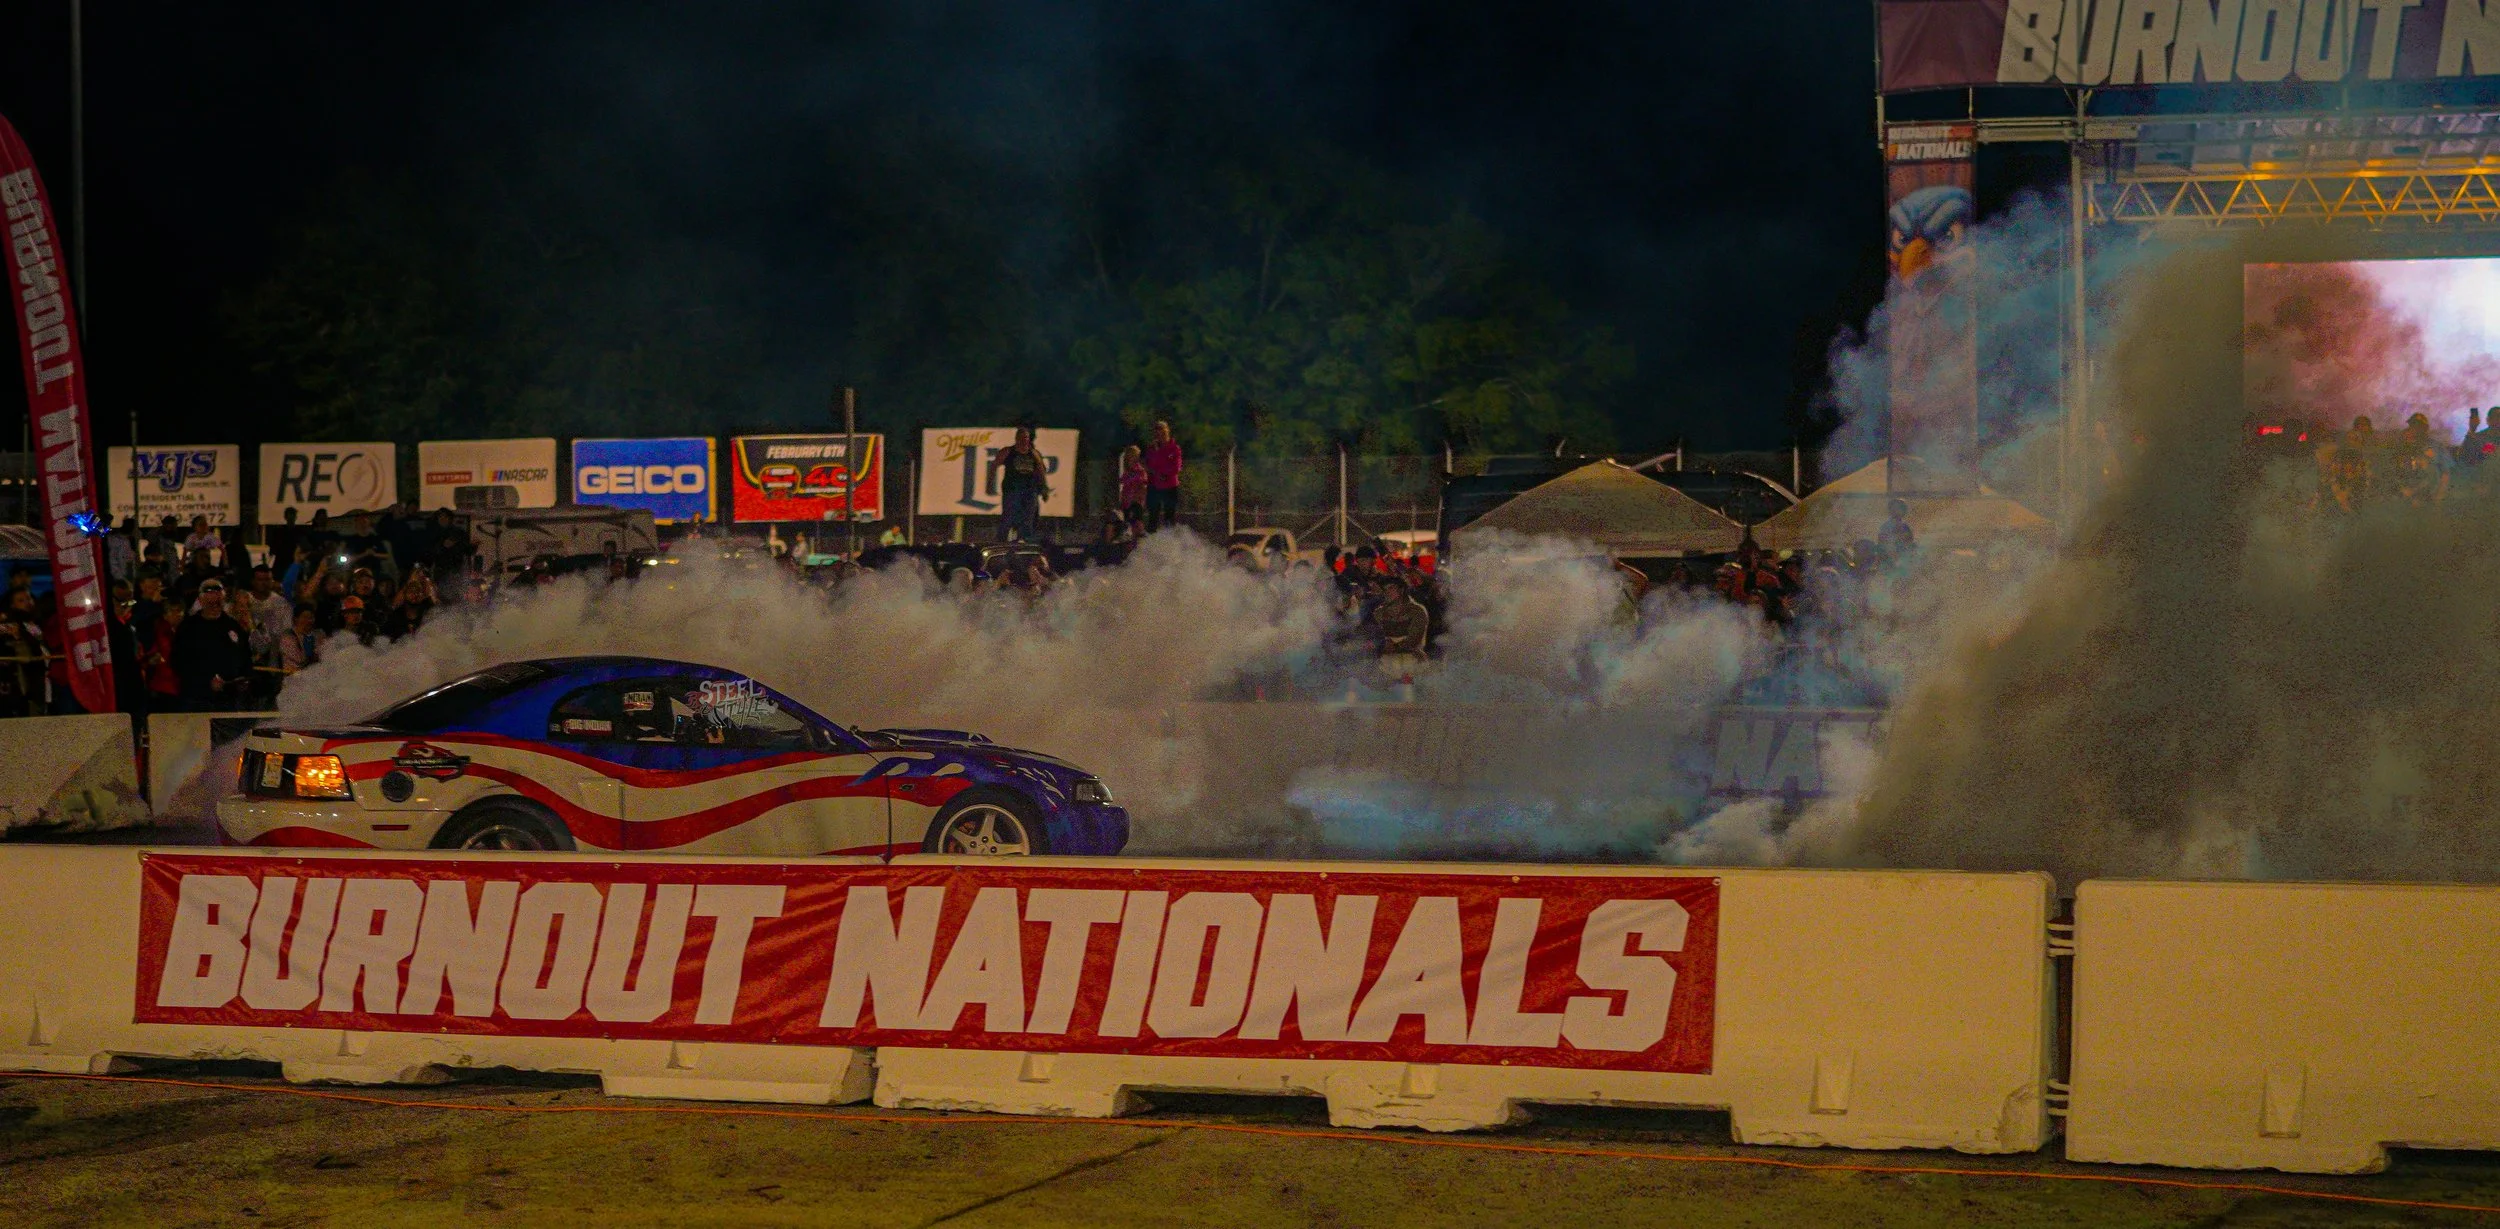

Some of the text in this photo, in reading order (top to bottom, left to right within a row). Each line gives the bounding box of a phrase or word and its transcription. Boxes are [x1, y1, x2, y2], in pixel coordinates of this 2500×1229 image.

[1996, 0, 2423, 84] BURNOUT
[1896, 141, 1971, 160] NATIONALS
[766, 445, 823, 459] FEBRUARY
[936, 431, 993, 461] Miller
[128, 449, 217, 493] MJS
[502, 468, 549, 482] NASCAR
[578, 465, 706, 495] GEICO
[699, 677, 762, 704] STEEL
[156, 873, 1690, 1053] BURNOUT NATIONALS
